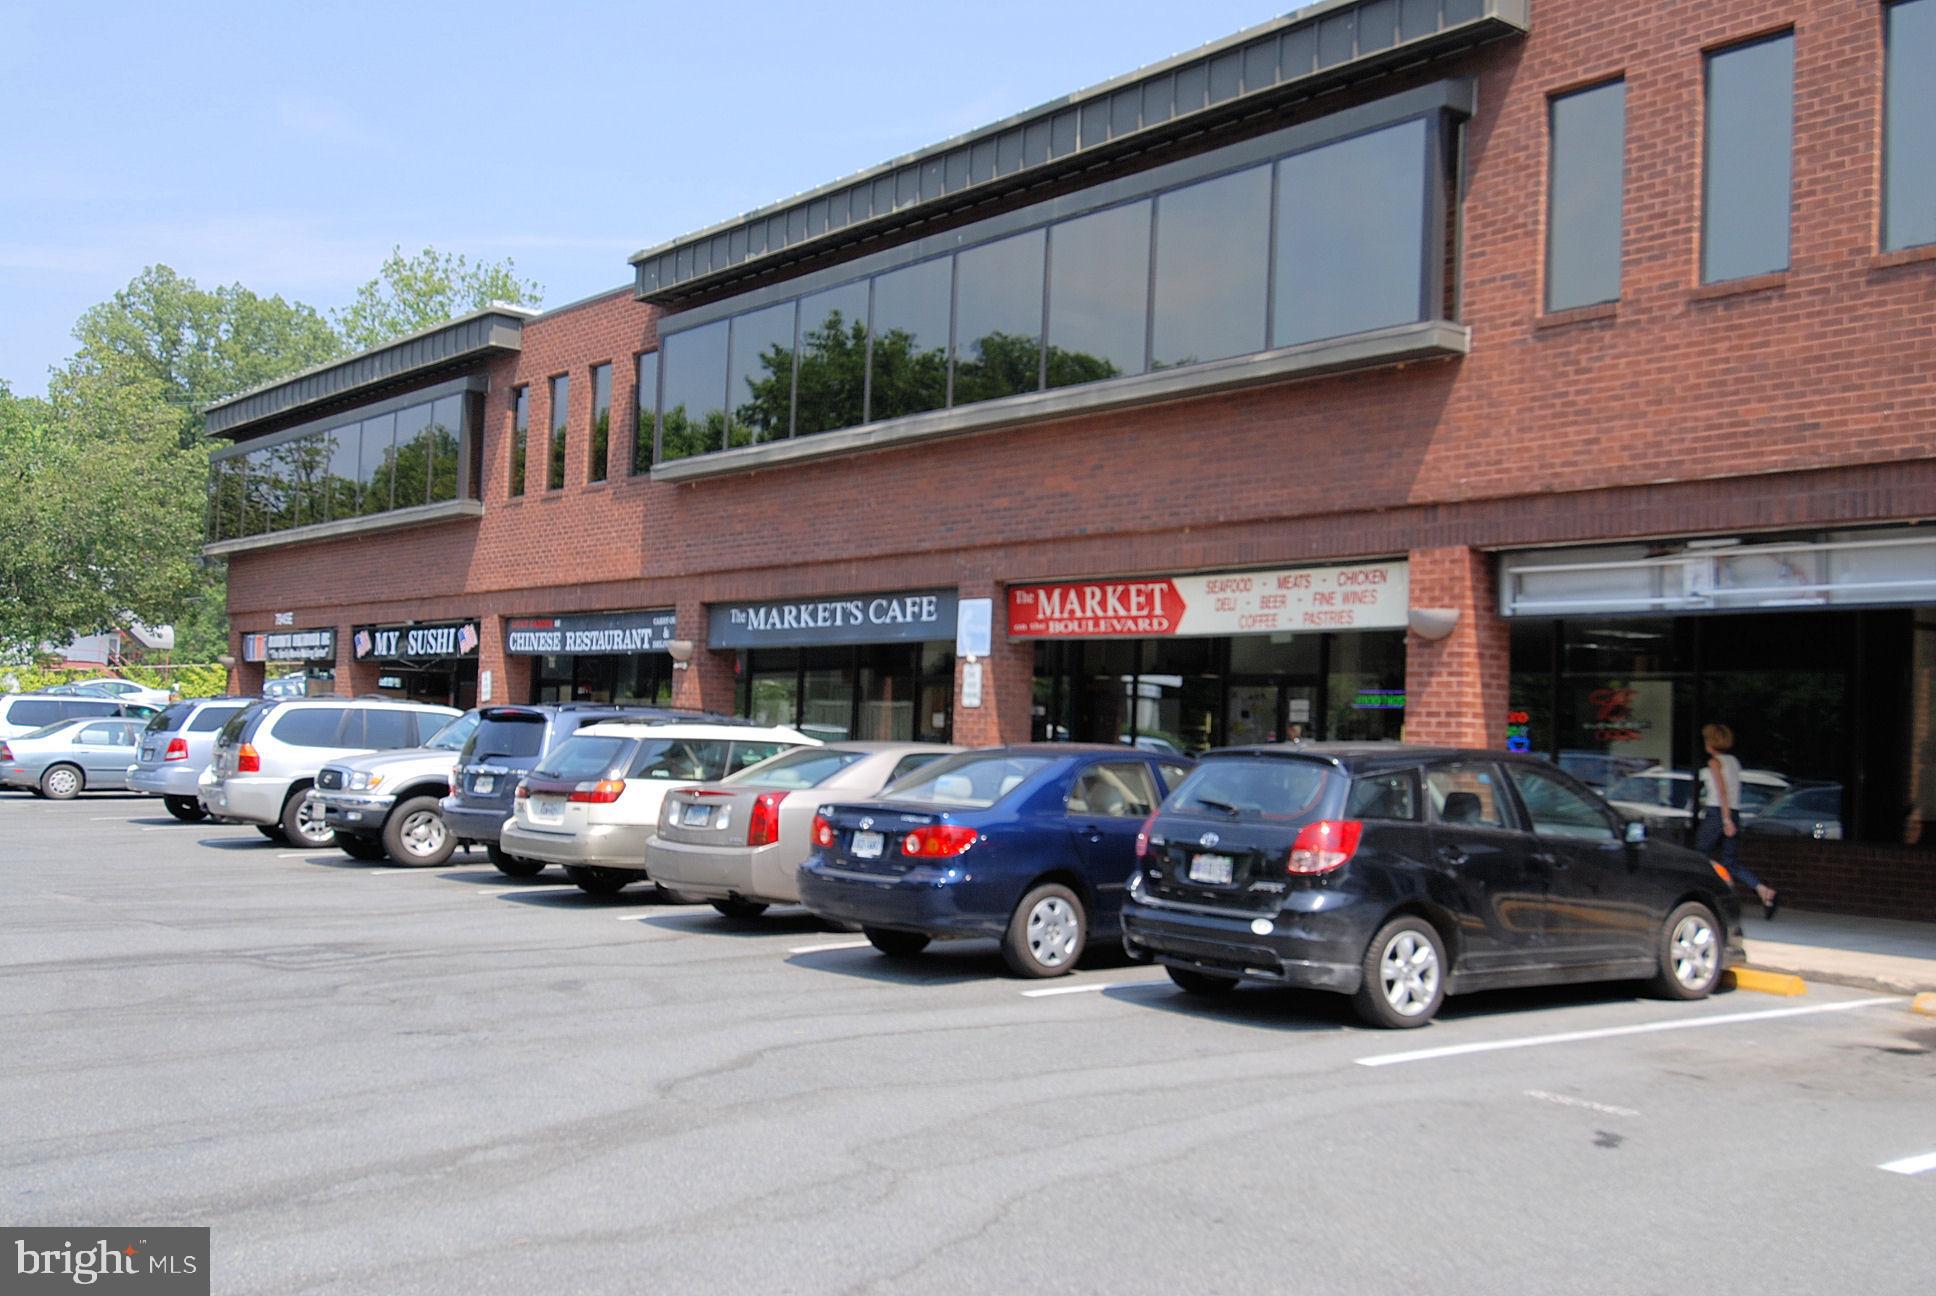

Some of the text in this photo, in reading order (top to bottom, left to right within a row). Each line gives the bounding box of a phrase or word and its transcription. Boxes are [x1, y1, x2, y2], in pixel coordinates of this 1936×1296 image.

[1205, 569, 1388, 594] SEAFOOD MEATS CHICKEN
[730, 595, 938, 630] The MARKET'S CAFE
[1015, 582, 1169, 620] The MARKET
[1215, 589, 1378, 612] DELI BEER FINE WINES
[1013, 615, 1170, 633] on the BOULEVARD
[1238, 609, 1354, 628] COFFEE PASTRIES
[374, 627, 456, 656] MY SUSHI
[509, 627, 653, 651] CHINESE RESTAURANT
